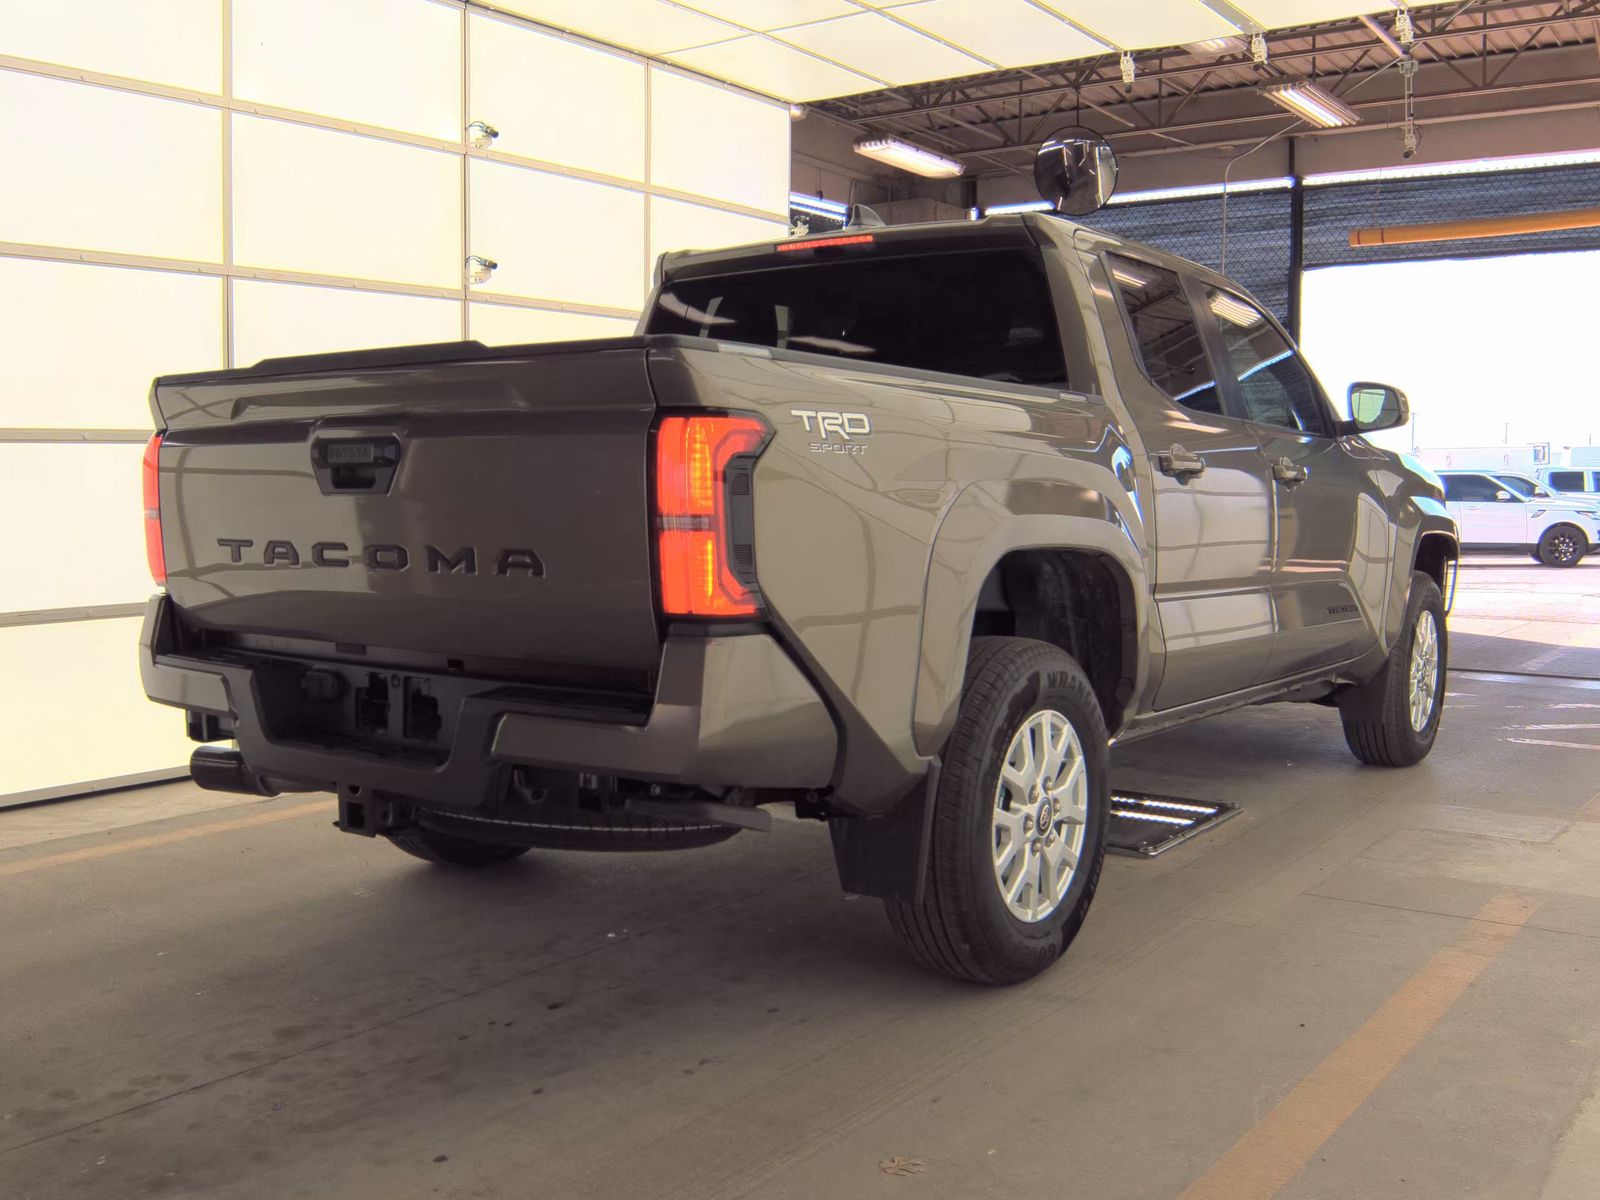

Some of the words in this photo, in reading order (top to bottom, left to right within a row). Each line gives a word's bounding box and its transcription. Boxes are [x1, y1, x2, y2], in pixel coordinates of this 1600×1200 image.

[791, 409, 870, 440] TRD
[809, 442, 868, 455] SPORT
[217, 538, 546, 578] TACOMA
